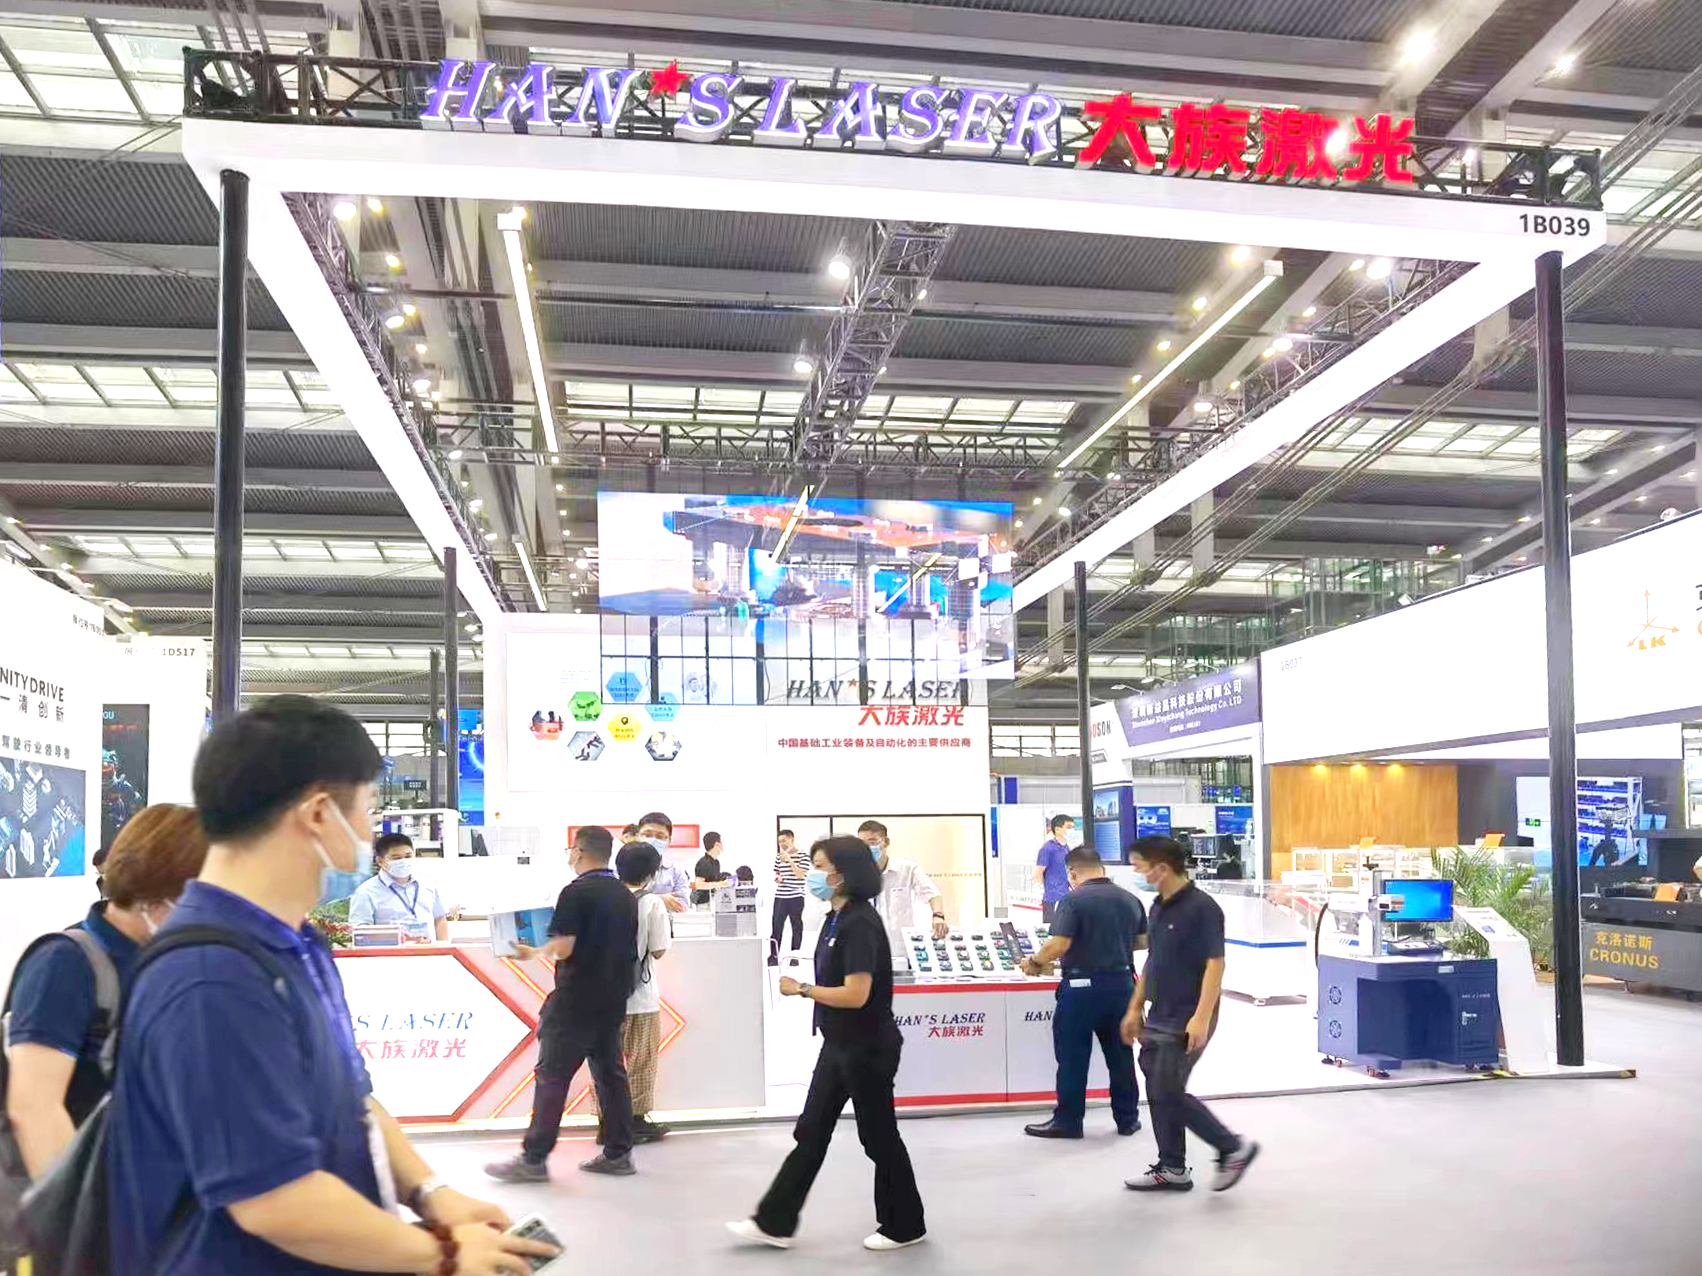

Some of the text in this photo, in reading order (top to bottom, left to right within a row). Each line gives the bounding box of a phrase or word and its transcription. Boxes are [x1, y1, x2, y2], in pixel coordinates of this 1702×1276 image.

[752, 78, 1062, 165] LASER
[1074, 91, 1417, 186] 大族激光
[1518, 212, 1591, 238] 1B039
[1589, 947, 1659, 969] CRONUS
[381, 1012, 473, 1030] LASER
[941, 1012, 986, 1025] LASER
